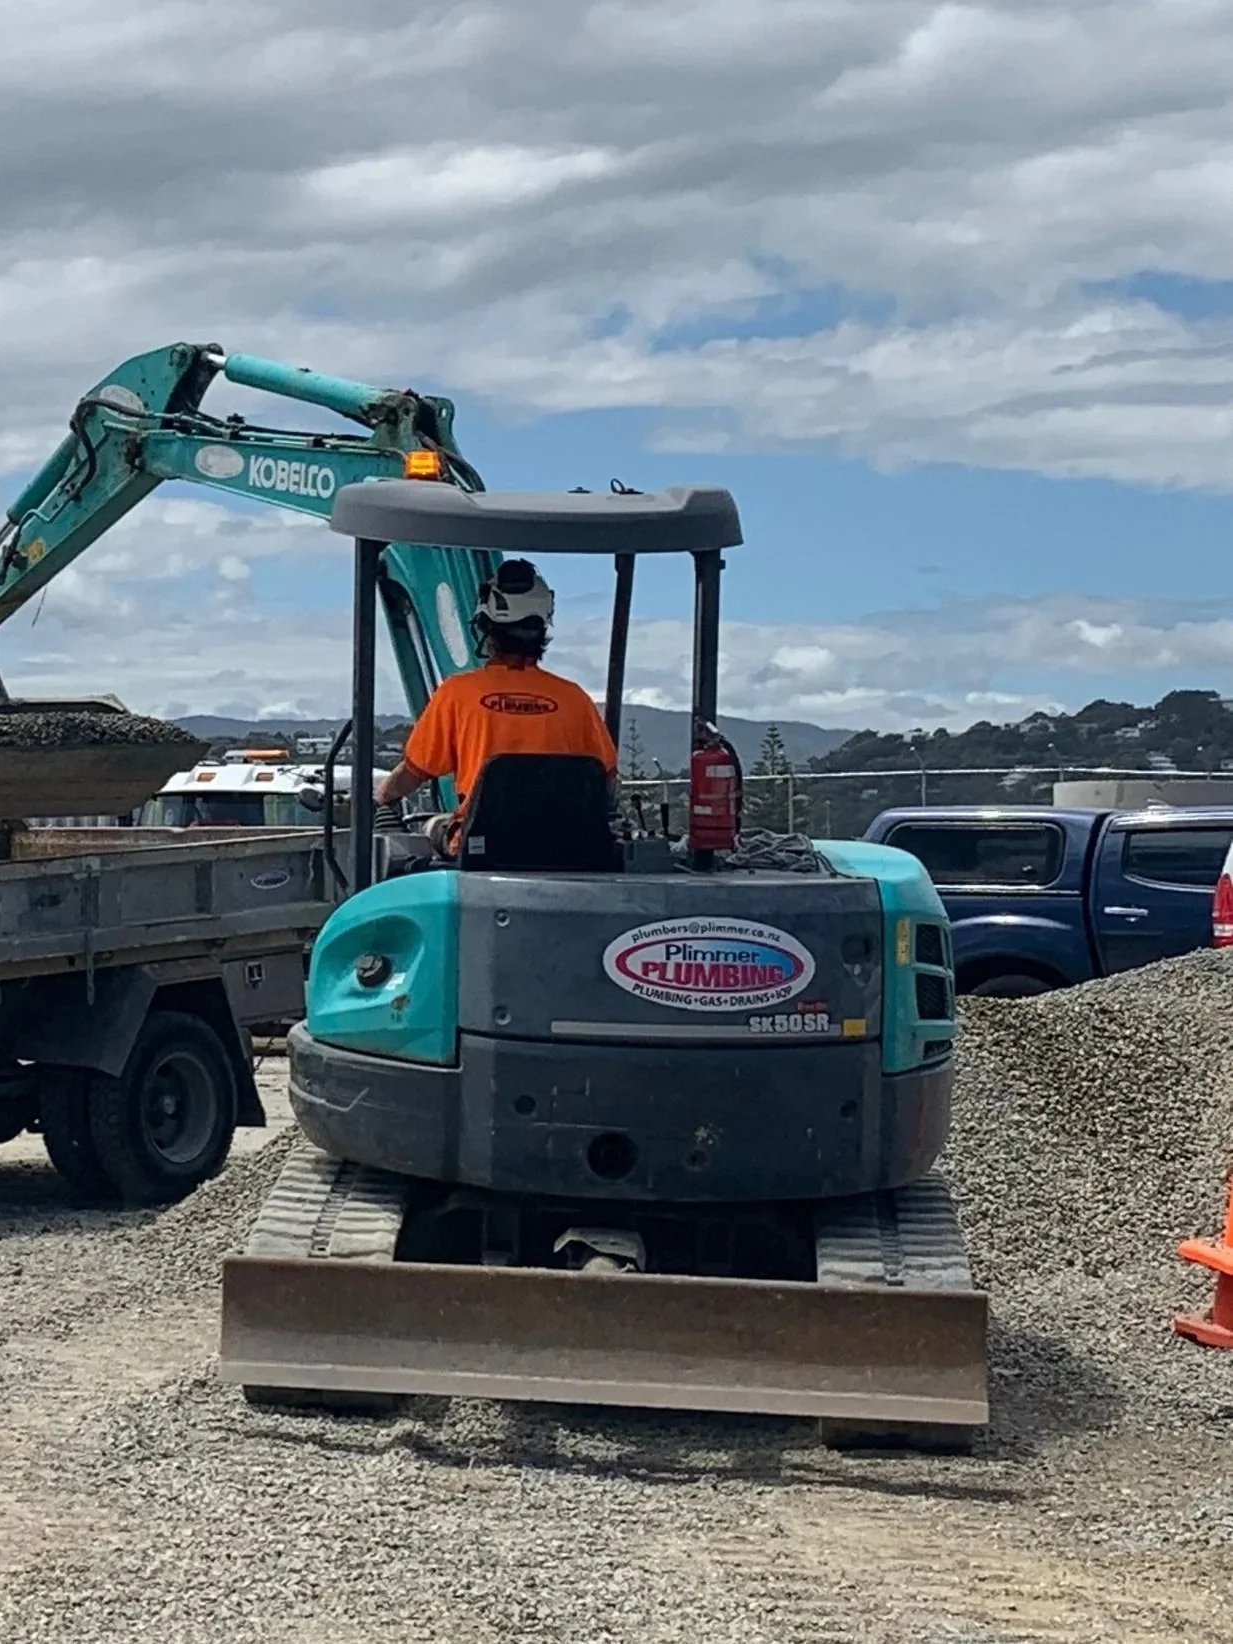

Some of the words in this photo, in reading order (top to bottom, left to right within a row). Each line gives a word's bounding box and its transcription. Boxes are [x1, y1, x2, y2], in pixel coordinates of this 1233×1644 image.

[248, 455, 335, 499] KOBELCO
[631, 920, 781, 943] plumbers@plimmer.co.nz
[665, 943, 760, 962] Plimmer
[641, 961, 784, 988] PLUMBING
[748, 1013, 830, 1034] SK50SR
